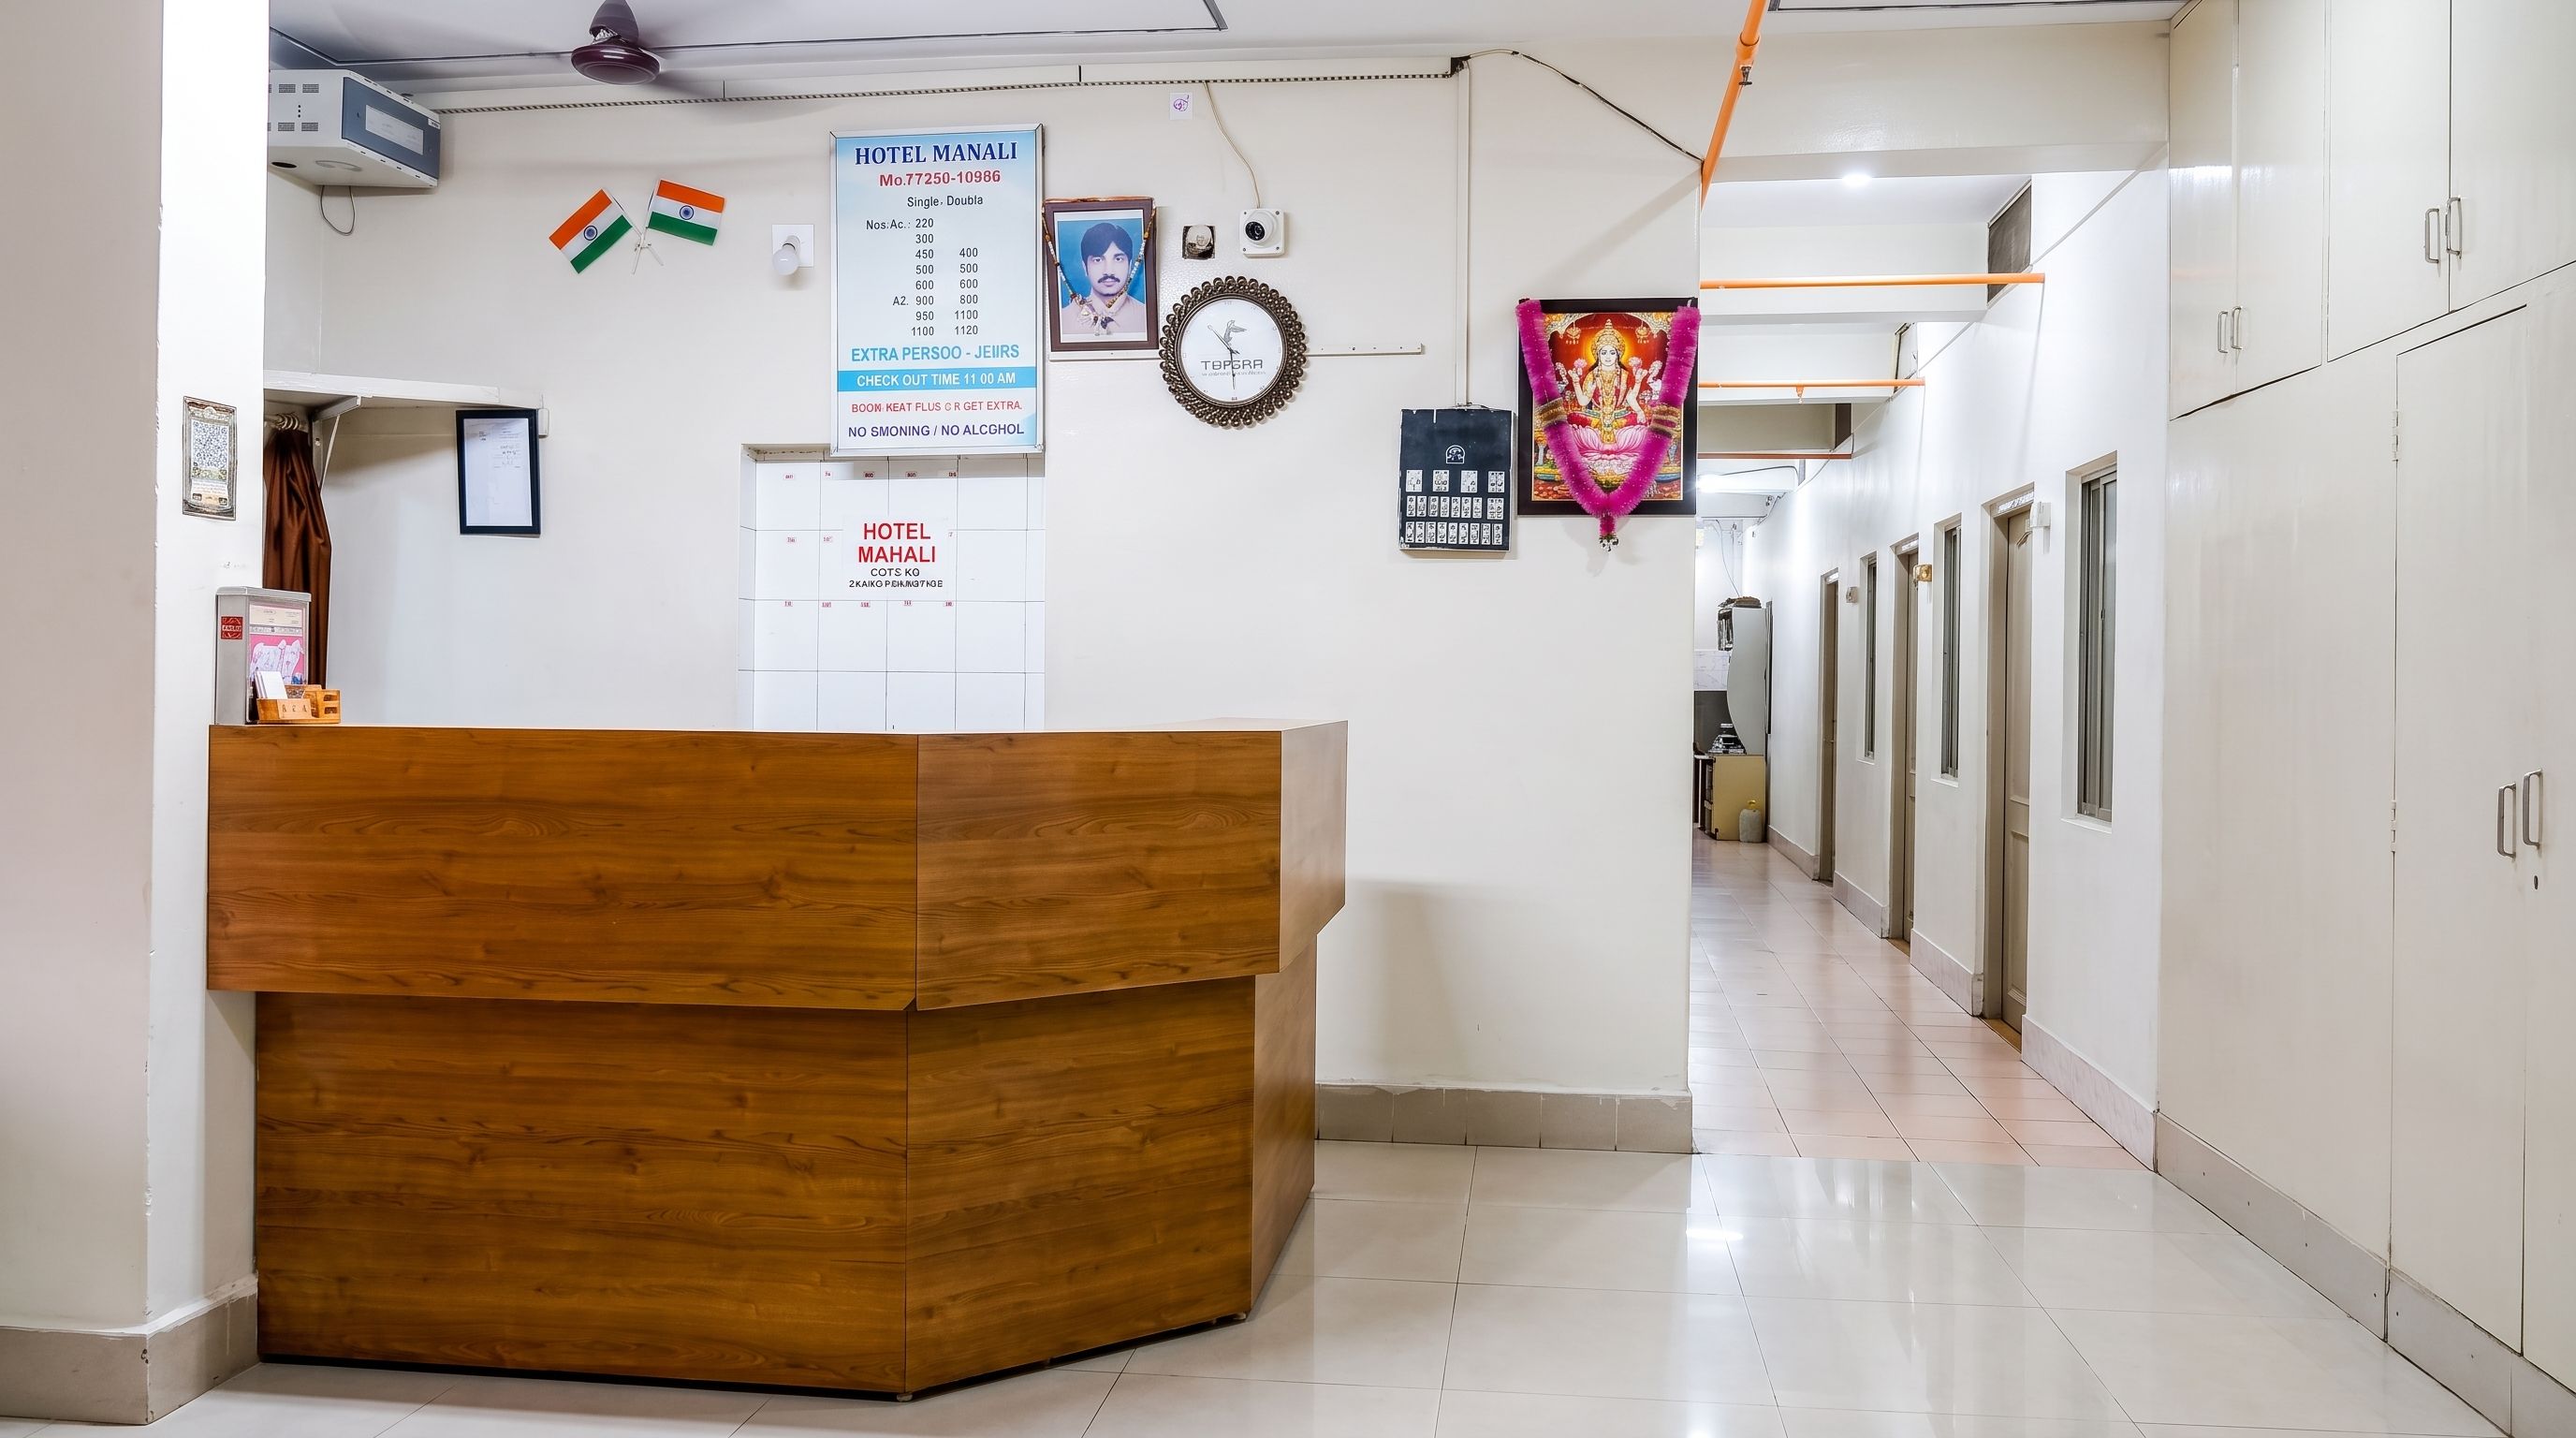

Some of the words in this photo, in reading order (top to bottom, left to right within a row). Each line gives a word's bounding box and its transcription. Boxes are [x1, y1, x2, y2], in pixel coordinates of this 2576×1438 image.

[856, 145, 927, 165] HOTEL
[933, 141, 1017, 162] MANALI
[879, 169, 1002, 186] Mo.77250-10986
[915, 218, 934, 228] 220
[915, 233, 934, 243] 300
[915, 249, 934, 259] 450
[959, 247, 978, 257] 400
[915, 264, 934, 274] 500
[959, 263, 978, 273] 500
[915, 280, 934, 290] 600
[959, 279, 978, 289] 600
[915, 296, 934, 305] 900
[959, 294, 978, 304] 800
[915, 311, 934, 321] 950
[955, 310, 978, 320] 1100
[911, 327, 934, 336] 1100
[955, 325, 978, 335] 1120
[852, 347, 899, 361] EXTRA
[902, 345, 962, 360] PERSOO
[856, 374, 900, 387] CHECK
[902, 374, 929, 386] OUT
[931, 374, 960, 385] TIME
[964, 373, 976, 385] 11
[980, 373, 994, 384] 00
[998, 373, 1016, 384] AM
[964, 402, 984, 410] GET
[848, 426, 867, 437] NO
[871, 425, 930, 437] SMONING
[941, 425, 959, 435] NO
[863, 522, 930, 540] HOTEL
[857, 546, 936, 563] MAHALI
